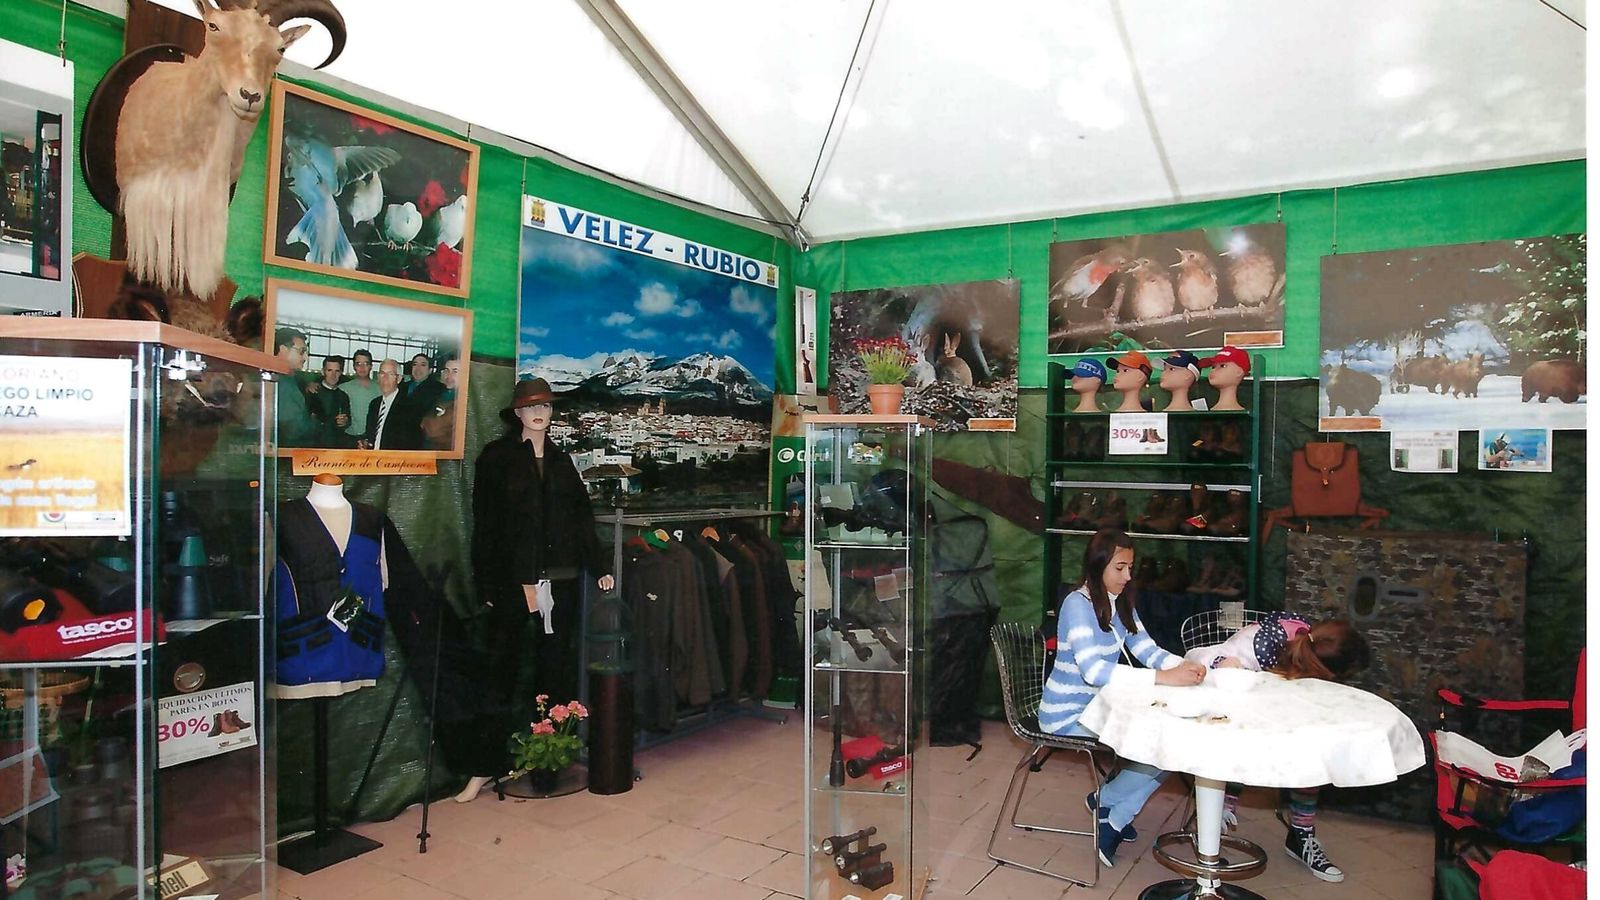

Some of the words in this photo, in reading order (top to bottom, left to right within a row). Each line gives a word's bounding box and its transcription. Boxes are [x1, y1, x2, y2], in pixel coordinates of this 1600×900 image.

[557, 206, 654, 255] VELEZ
[684, 243, 760, 281] RUBIO
[36, 388, 94, 401] LIMPIO
[0, 405, 38, 418] AZA
[1111, 428, 1141, 439] 30%
[359, 457, 371, 468] de
[57, 617, 134, 640] tasco
[170, 705, 197, 716] PARES
[211, 697, 238, 708] BOTAS
